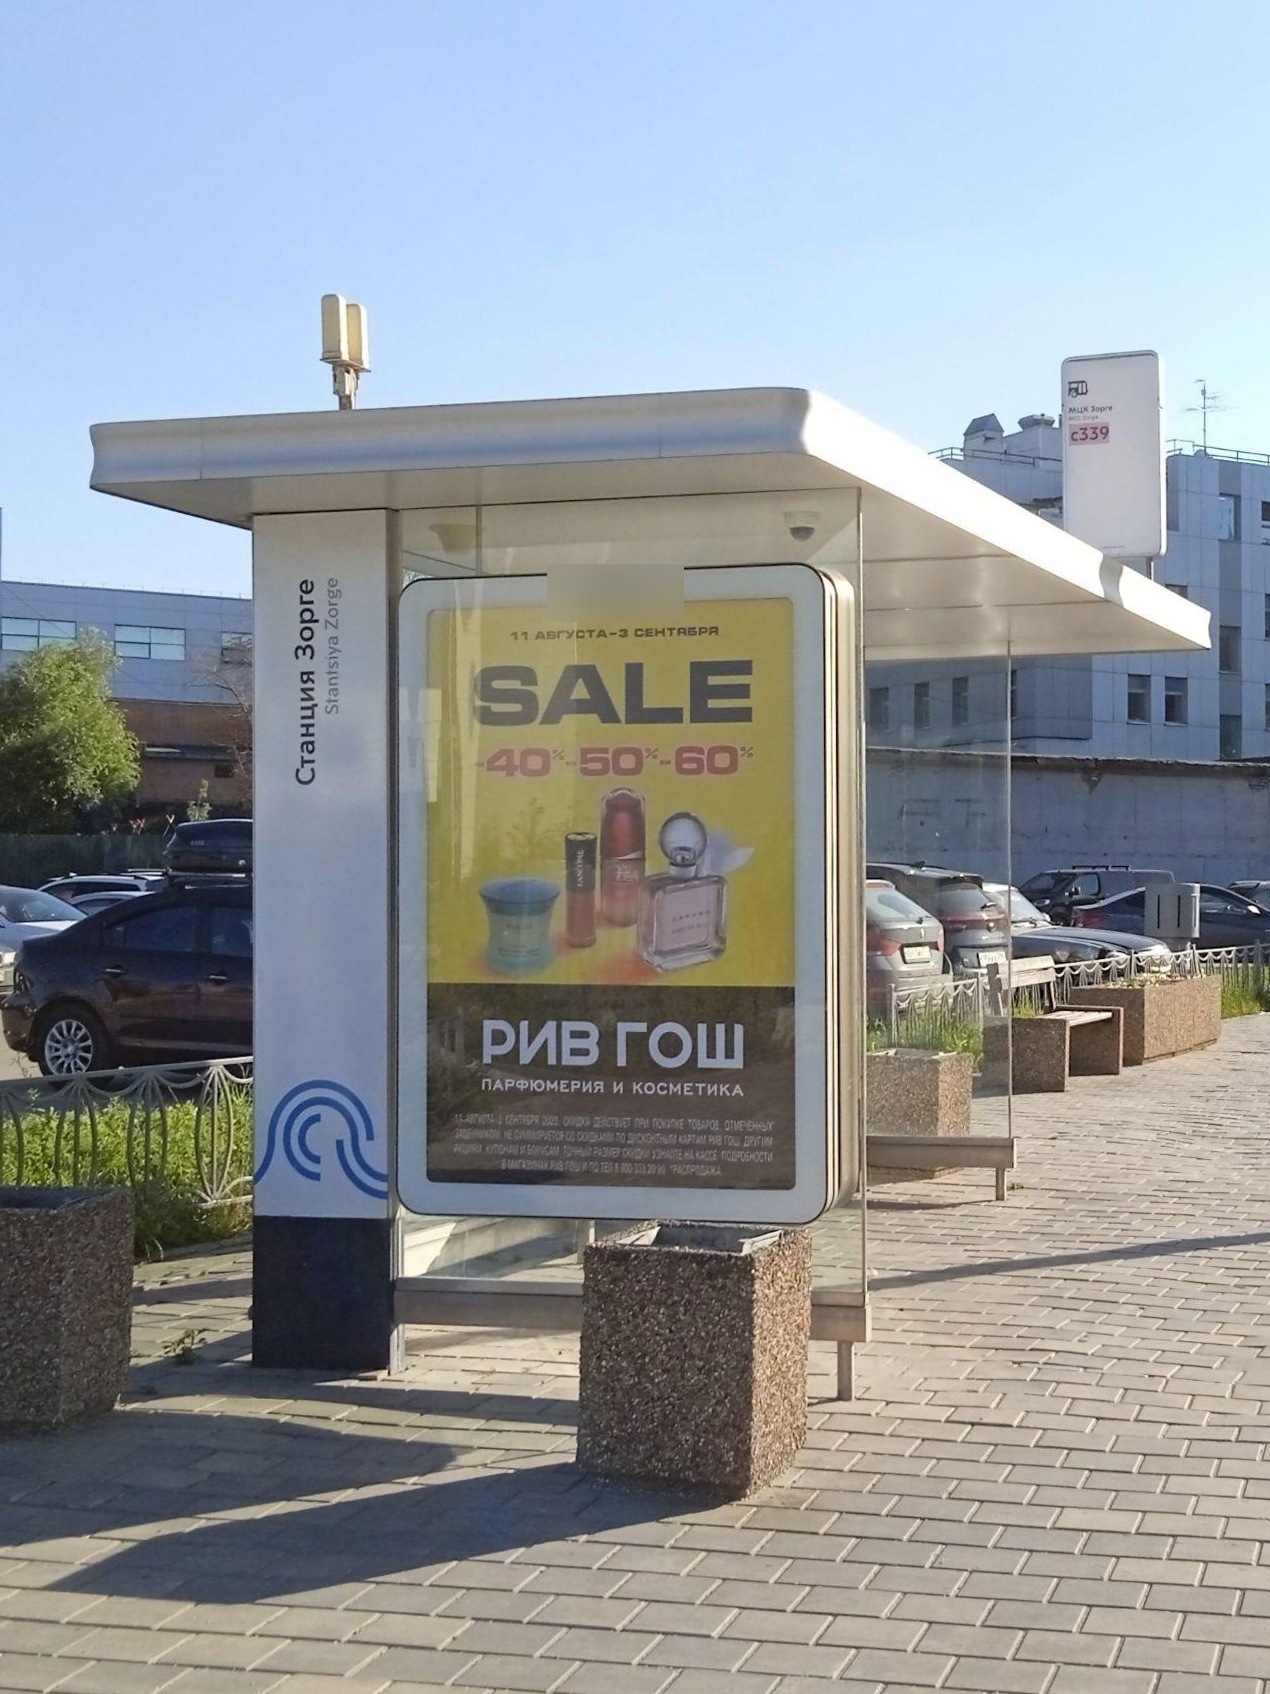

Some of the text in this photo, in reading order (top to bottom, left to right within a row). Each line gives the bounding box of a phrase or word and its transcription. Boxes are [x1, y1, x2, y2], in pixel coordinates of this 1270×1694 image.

[325, 577, 342, 715] Stantsiya Zorge
[510, 631, 529, 641] 11
[634, 626, 720, 638] СЕНТЯБРЯ
[294, 578, 319, 786] Станция Зорге
[473, 659, 753, 727] SALE
[482, 1019, 745, 1069] РИВ ГОШ
[481, 1078, 745, 1097] ПАРФЮМЕРИЯ И КОСМЕТИКА
